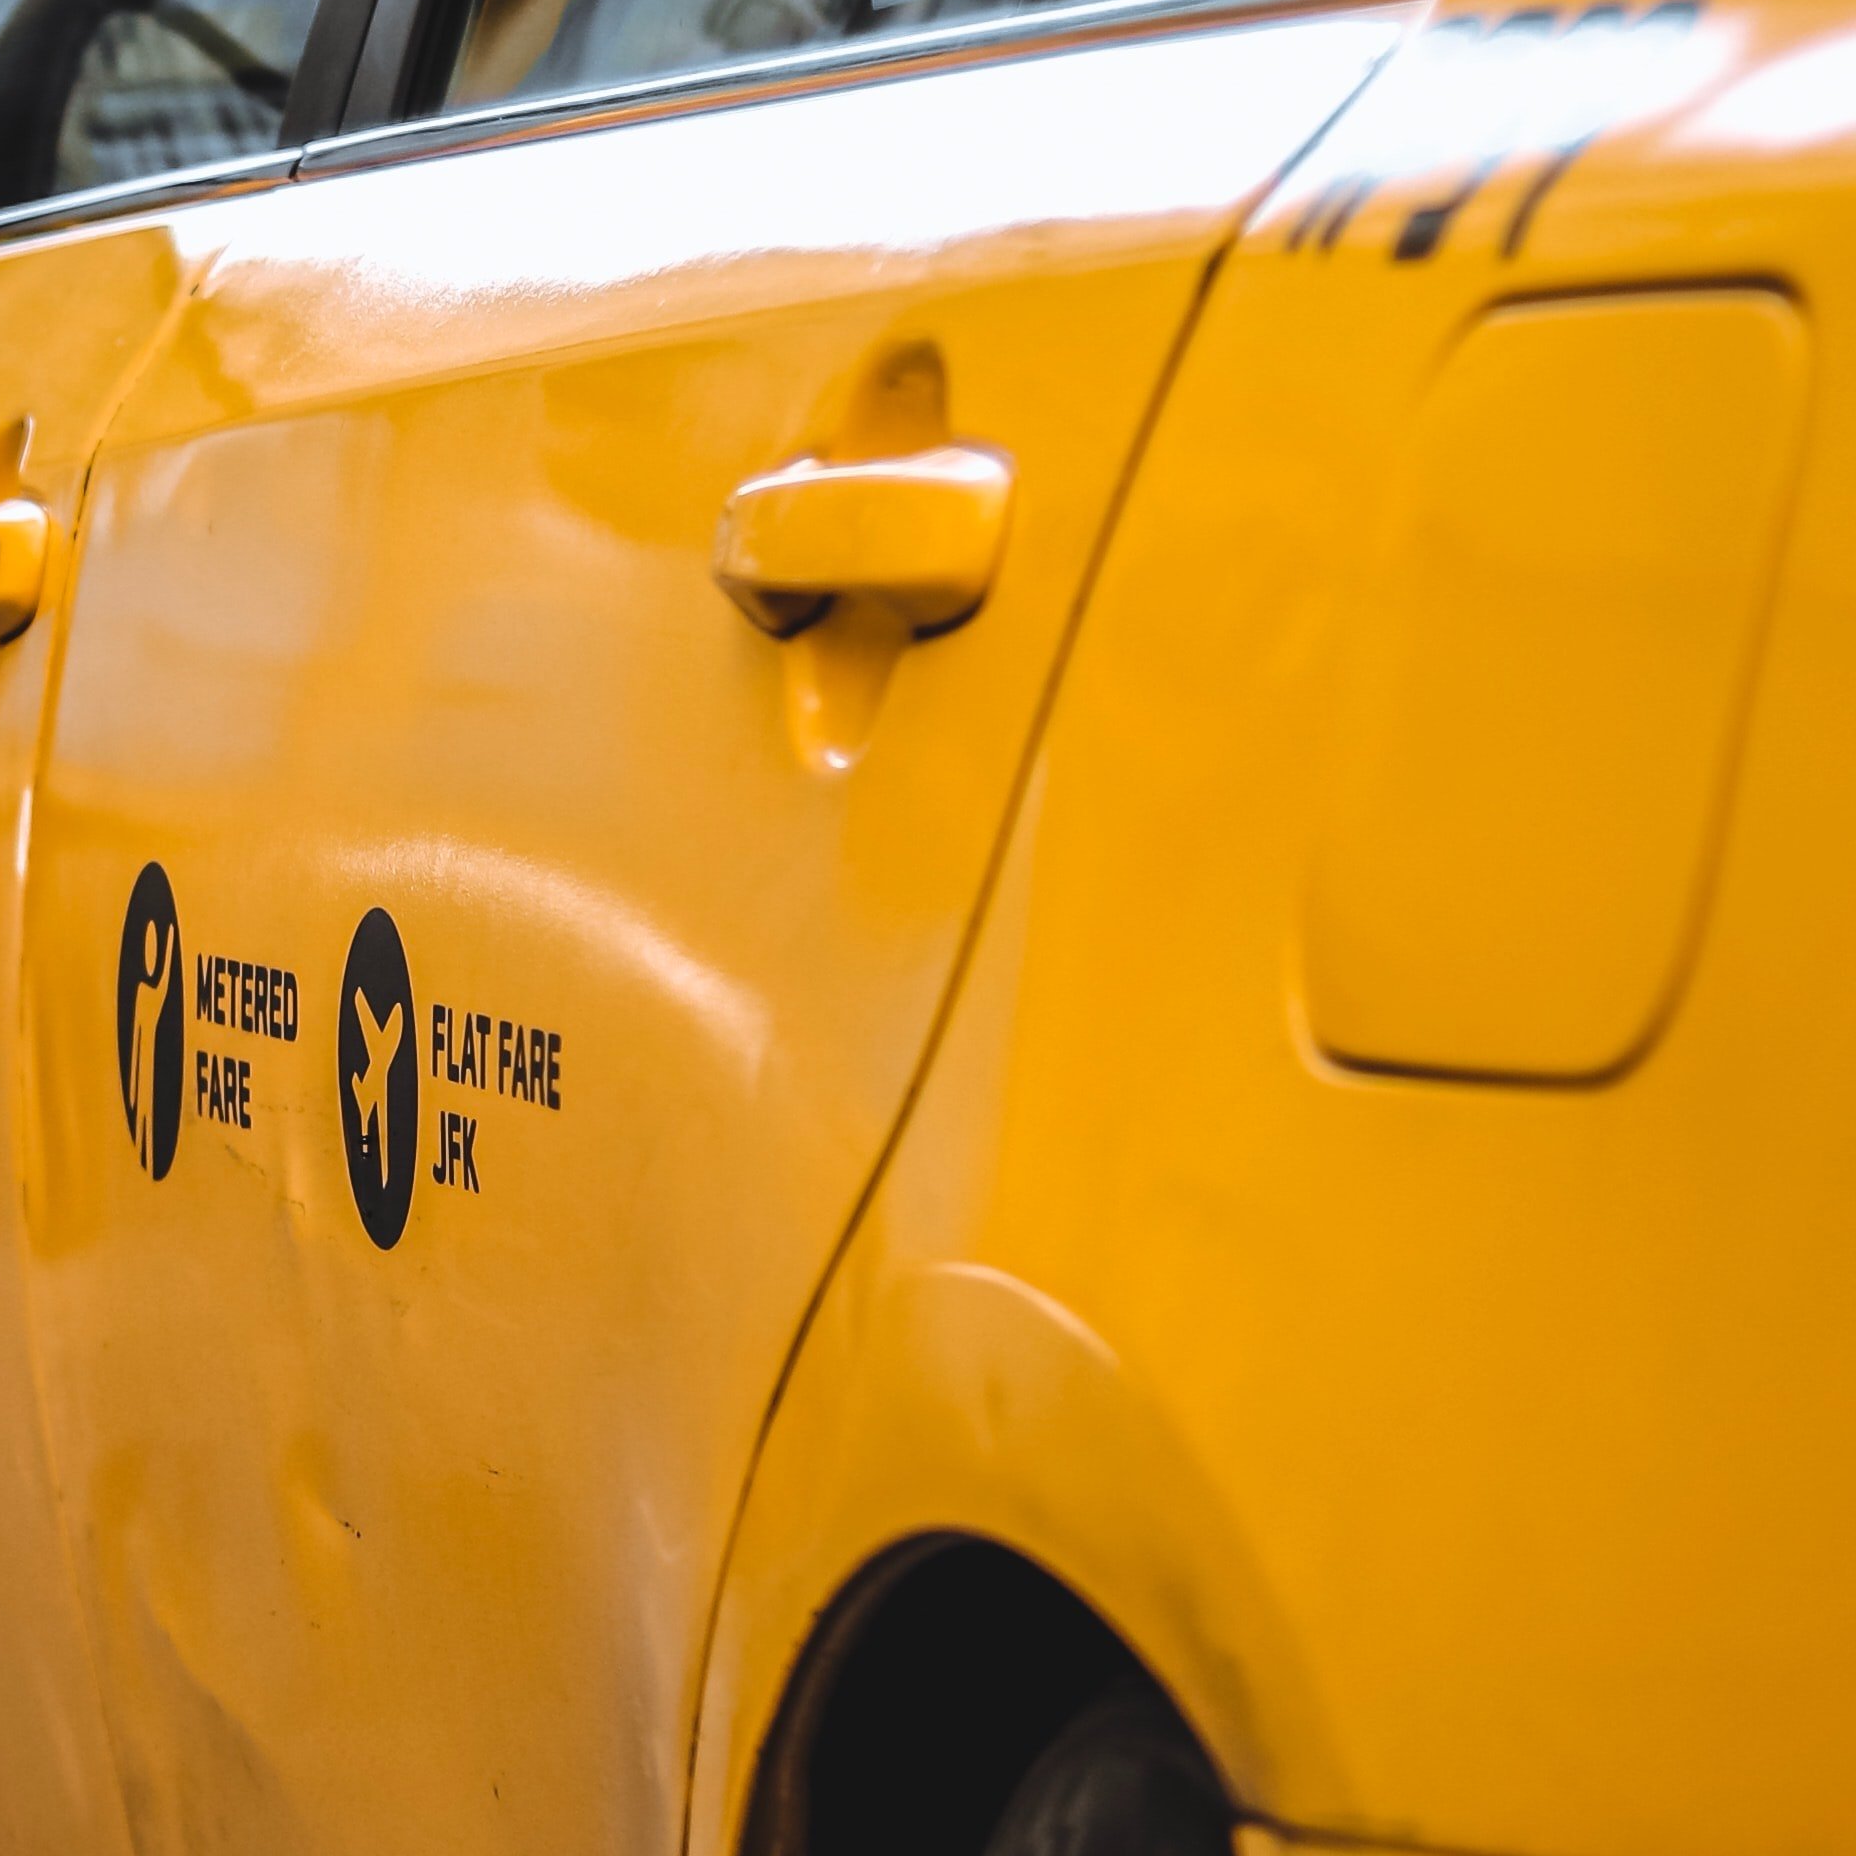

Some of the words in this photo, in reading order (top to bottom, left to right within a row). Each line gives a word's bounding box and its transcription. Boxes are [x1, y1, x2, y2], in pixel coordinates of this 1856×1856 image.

[196, 952, 298, 1042] METERED
[196, 1050, 251, 1130] FARE
[432, 1004, 491, 1090] FLAT
[498, 1020, 561, 1111] FARE
[432, 1110, 480, 1194] JFK
